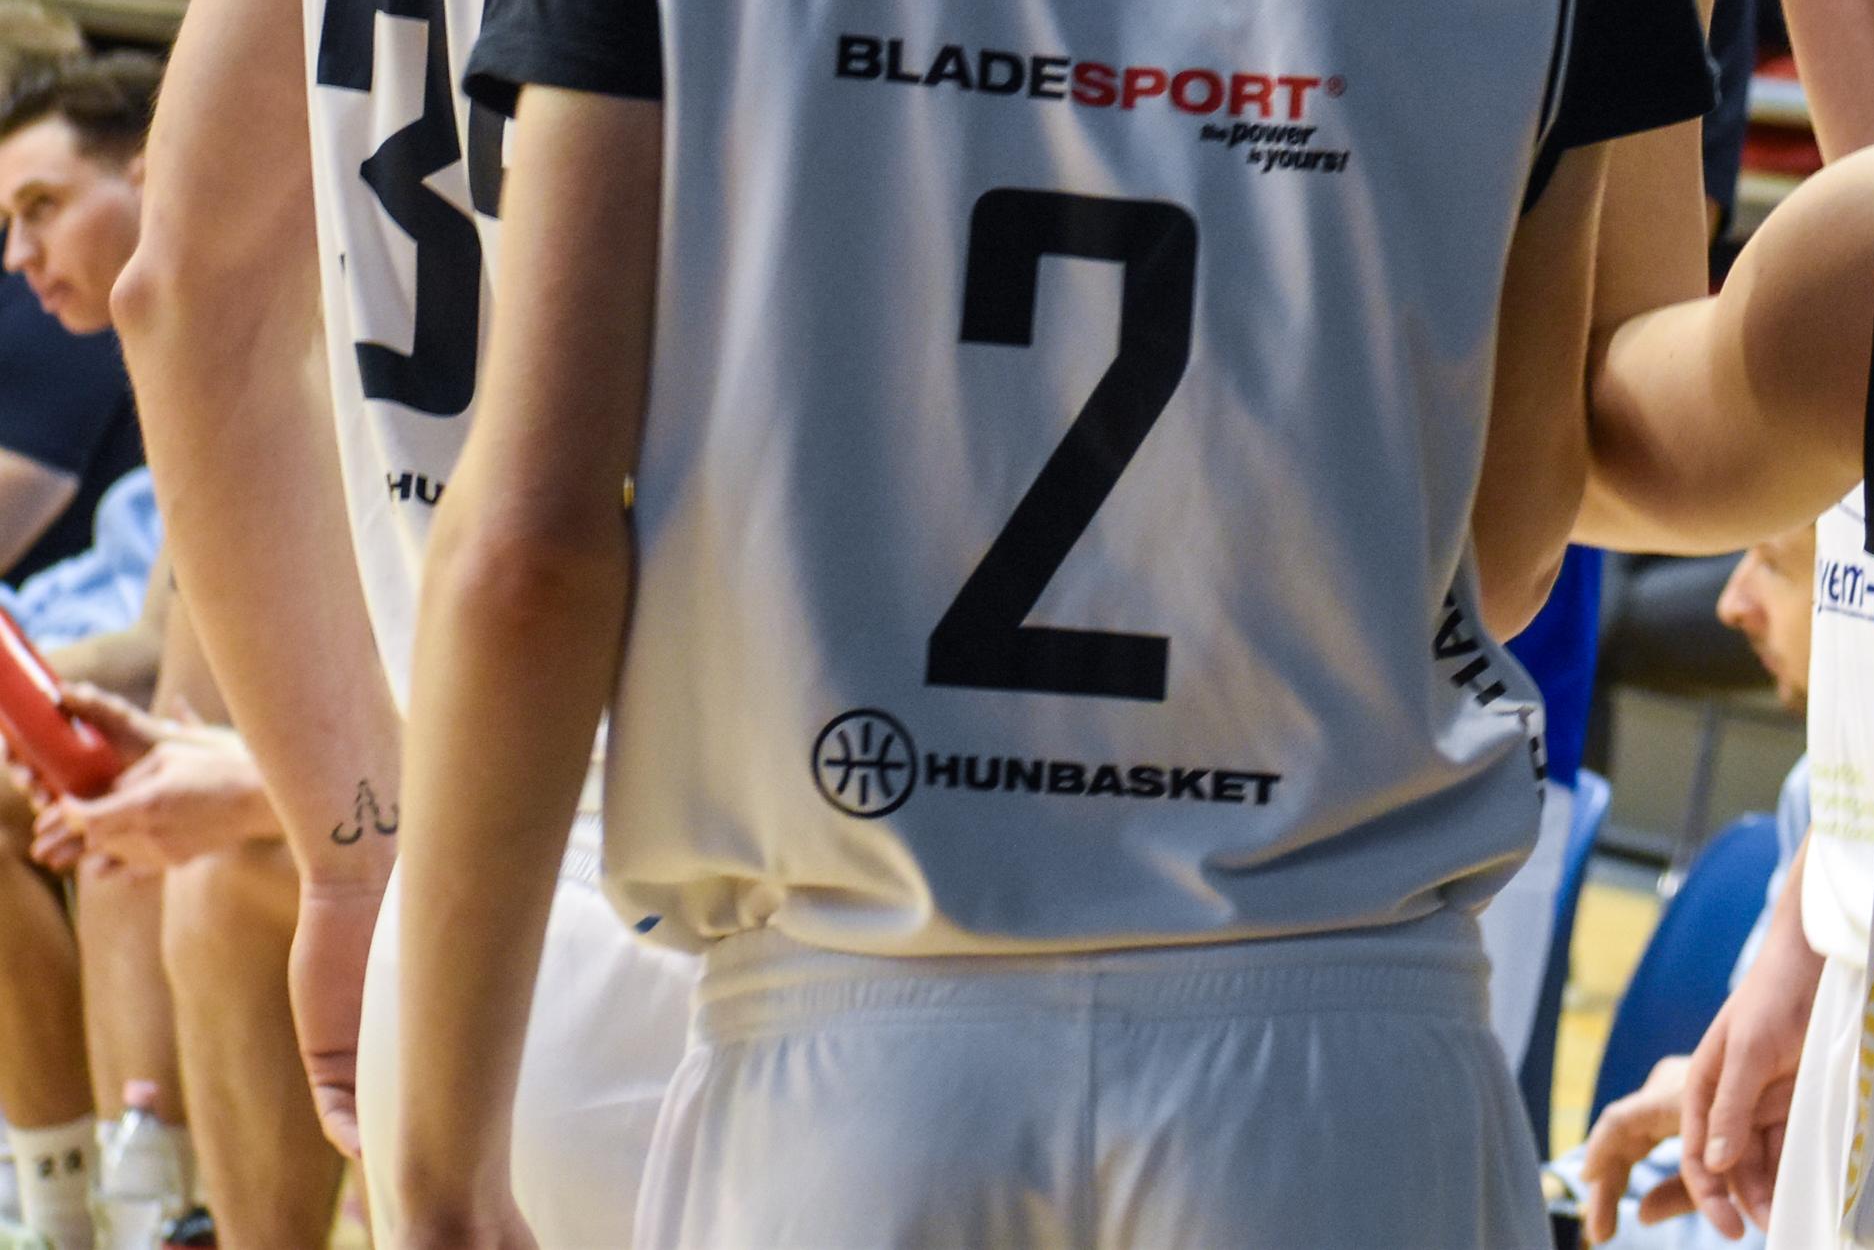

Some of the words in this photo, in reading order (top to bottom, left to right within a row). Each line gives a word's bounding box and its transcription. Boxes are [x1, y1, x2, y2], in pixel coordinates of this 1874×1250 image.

[1228, 122, 1317, 148] power
[925, 186, 1196, 703] 2
[924, 753, 1283, 806] HUNBASKET
